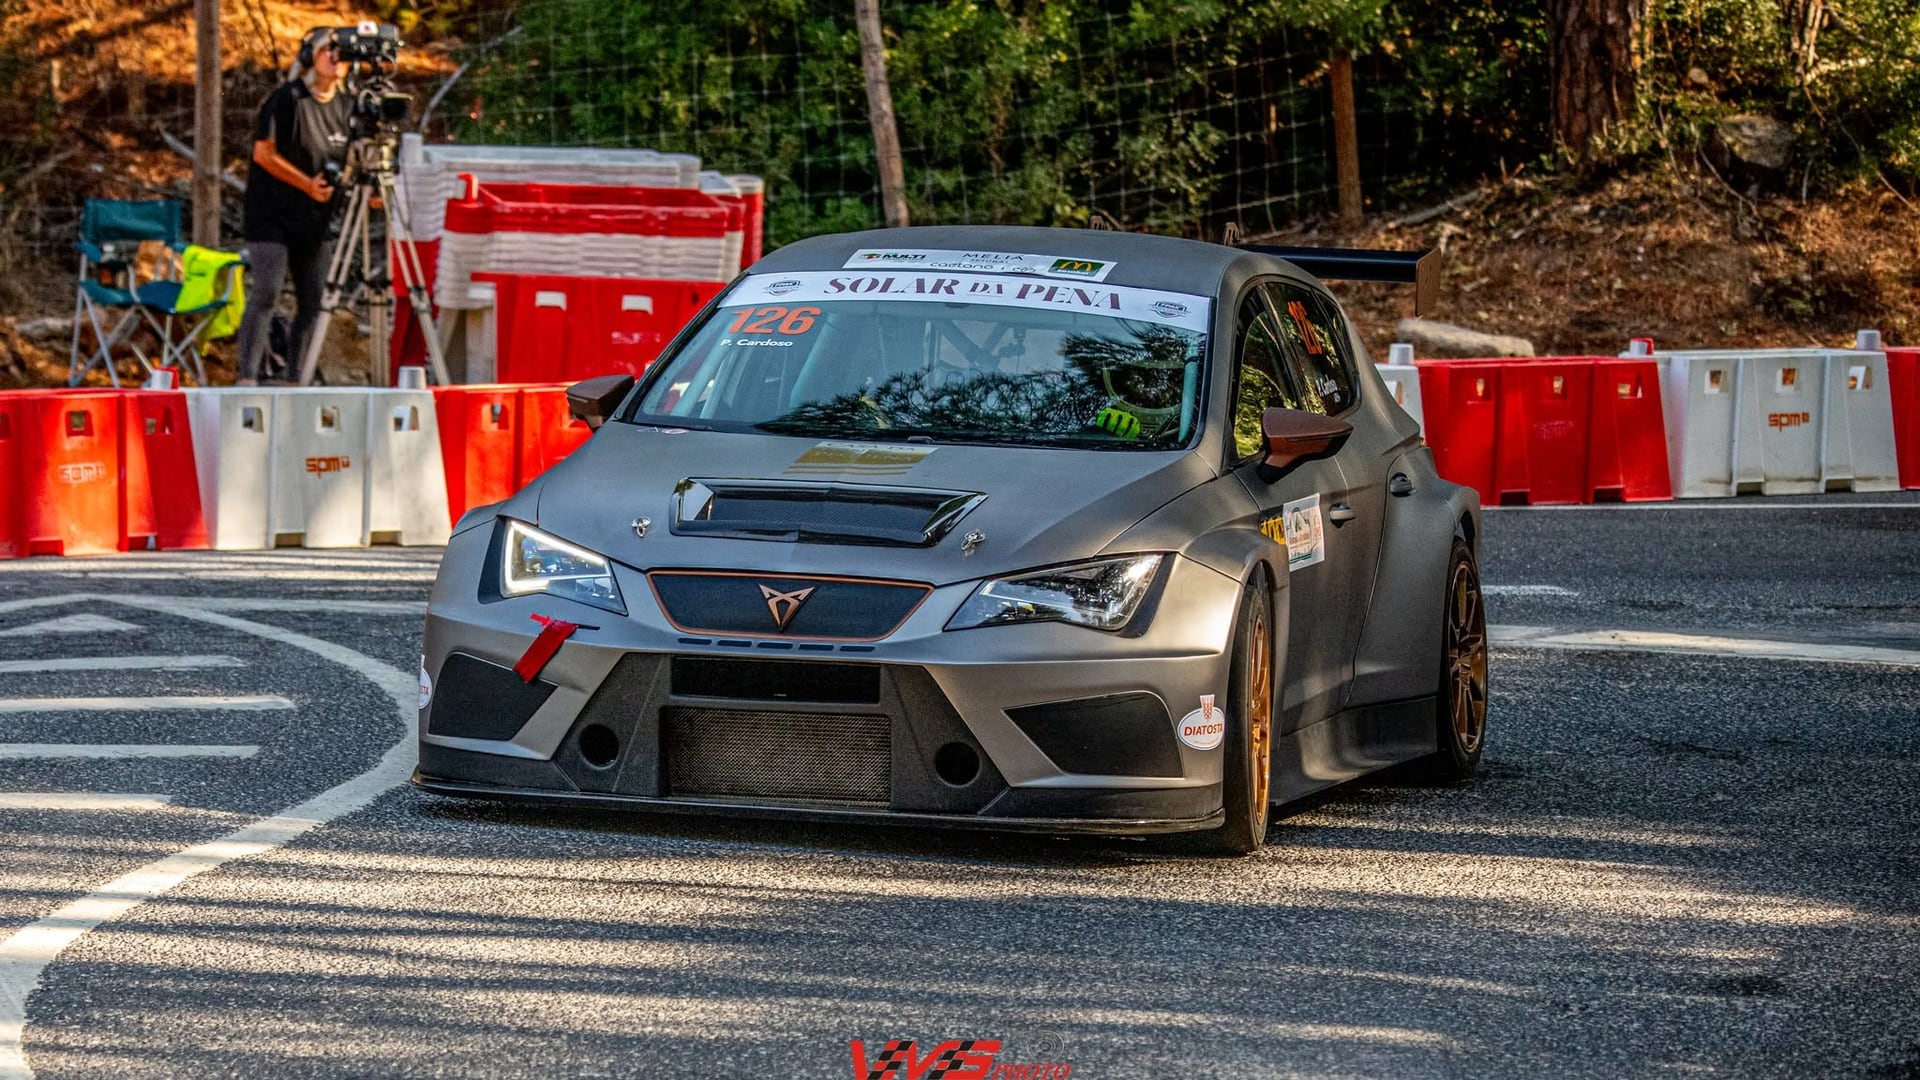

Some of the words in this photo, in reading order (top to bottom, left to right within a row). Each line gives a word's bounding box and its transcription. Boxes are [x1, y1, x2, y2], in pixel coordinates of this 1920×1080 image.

[930, 262, 994, 270] caetano
[824, 277, 960, 294] SOLAR
[969, 282, 1004, 295] DA
[1015, 283, 1122, 310] PENA
[728, 306, 821, 334] 126
[737, 339, 793, 347] Cardoso
[1184, 723, 1223, 736] DIATOSTA
